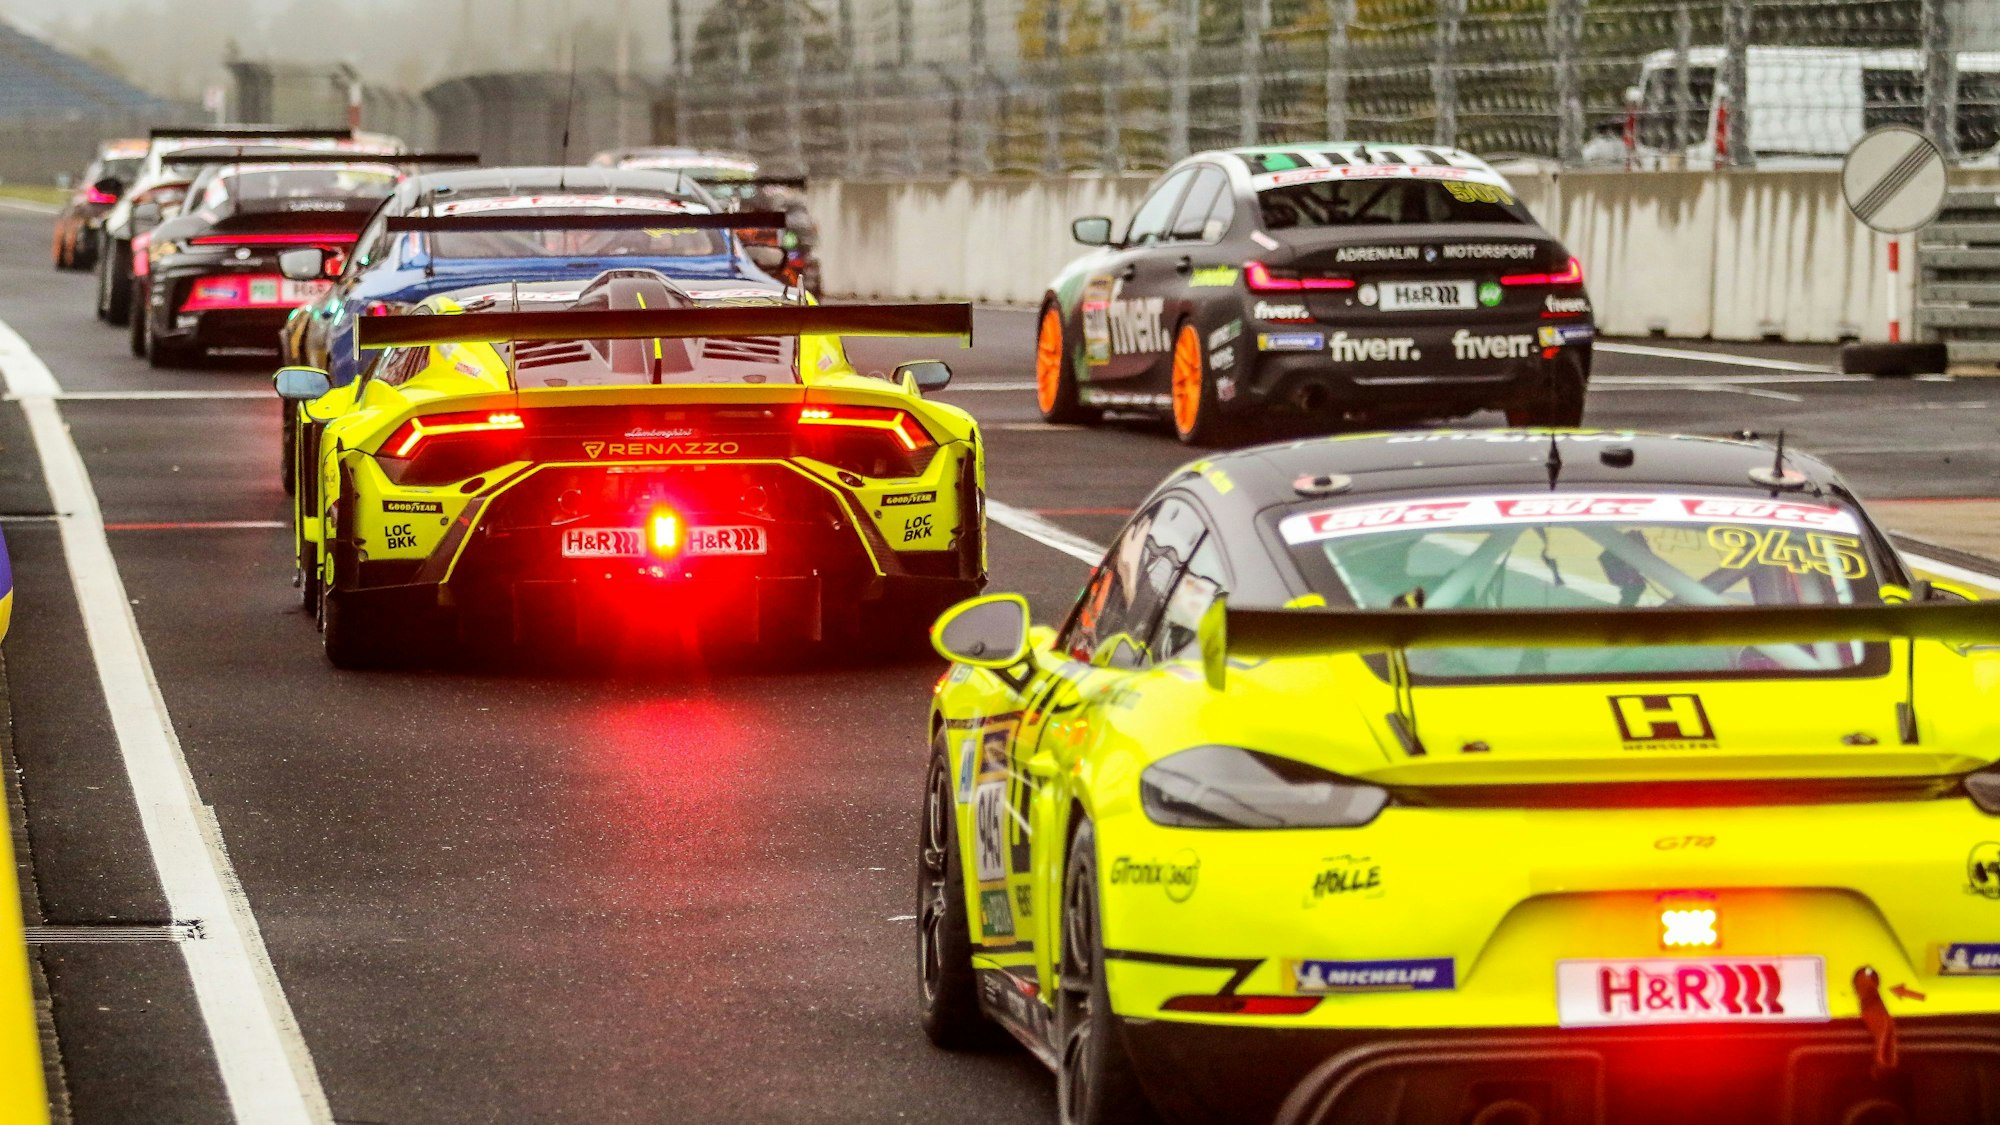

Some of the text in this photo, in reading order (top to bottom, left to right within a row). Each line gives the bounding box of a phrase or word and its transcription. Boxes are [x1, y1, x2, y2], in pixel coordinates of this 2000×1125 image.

[1335, 244, 1537, 263] ADRENALIN MOTORSPORT
[1396, 286, 1432, 304] H&R
[1329, 331, 1422, 362] fiverr.
[1451, 329, 1540, 360] fiverr.
[608, 442, 739, 456] RENAZZO
[384, 523, 412, 538] LOC
[904, 514, 932, 530] LOC
[387, 536, 417, 550] BKK
[567, 531, 611, 551] H&R
[689, 531, 732, 550] H&R
[903, 526, 933, 542] BKK
[1706, 525, 1868, 580] 945
[1328, 967, 1437, 985] MICHELIN
[1601, 966, 1710, 1013] H&R
